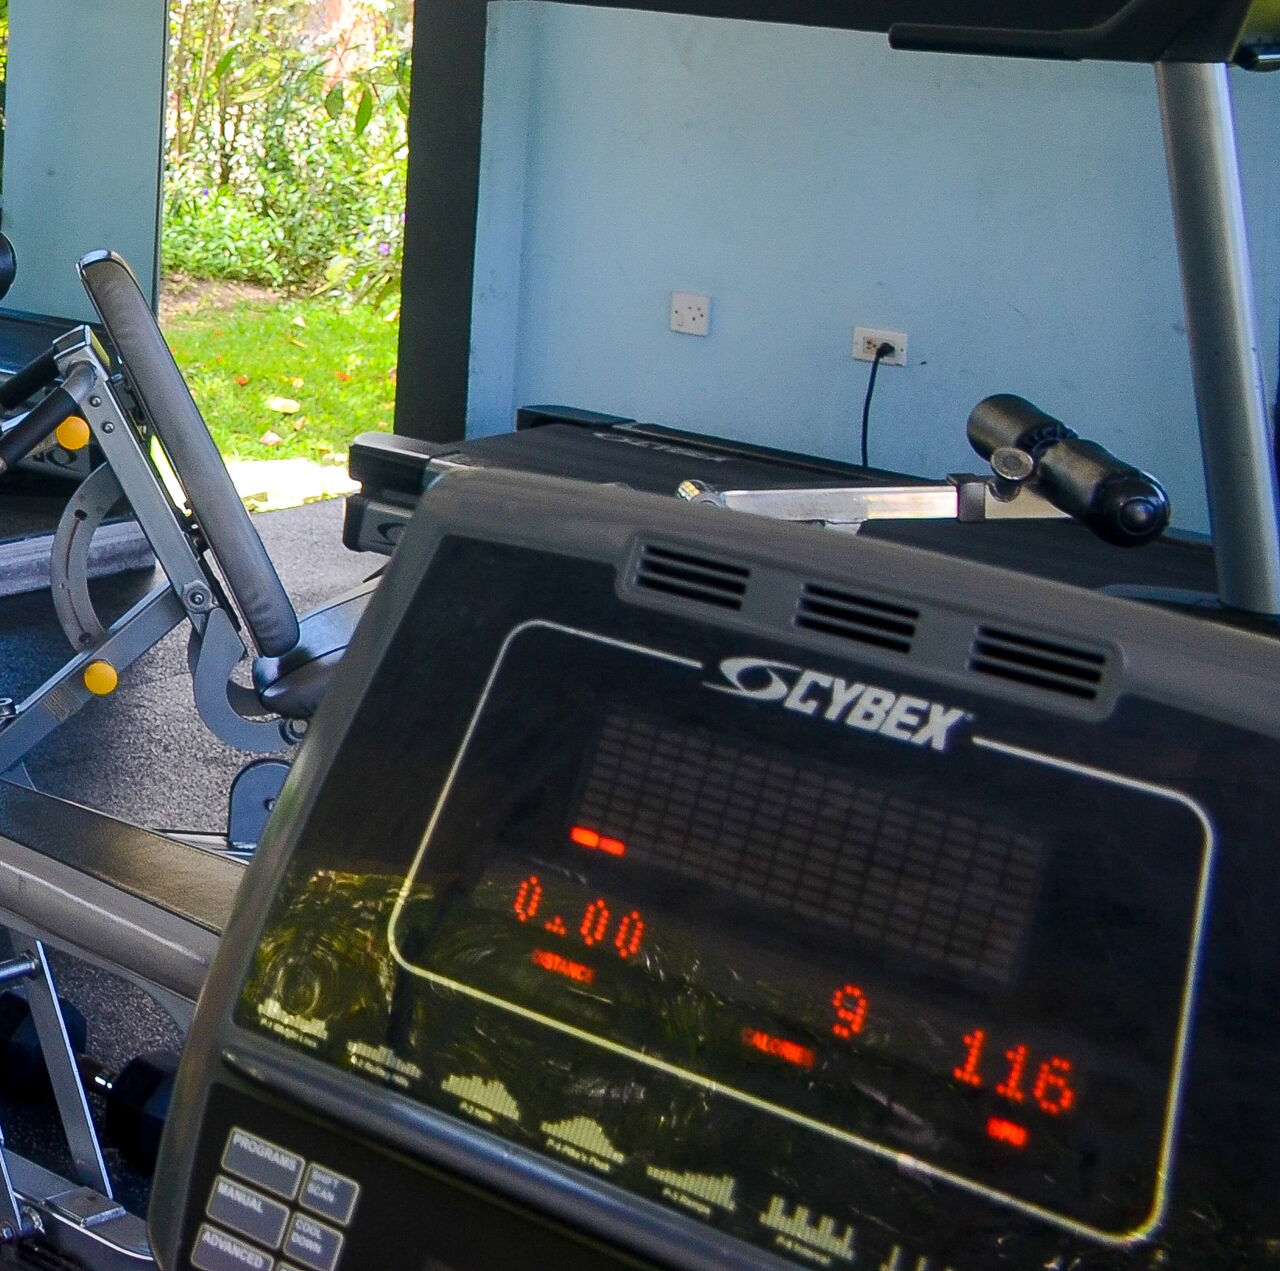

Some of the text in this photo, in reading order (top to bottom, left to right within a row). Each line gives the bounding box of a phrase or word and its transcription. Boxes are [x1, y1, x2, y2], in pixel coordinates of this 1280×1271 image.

[783, 670, 964, 751] CYBEX
[832, 984, 868, 1040] 9
[953, 1028, 1074, 1115] 116
[232, 1134, 298, 1172] PROGRAMS
[216, 1182, 264, 1214] MANUAL
[201, 1231, 264, 1269] ADVANCED
